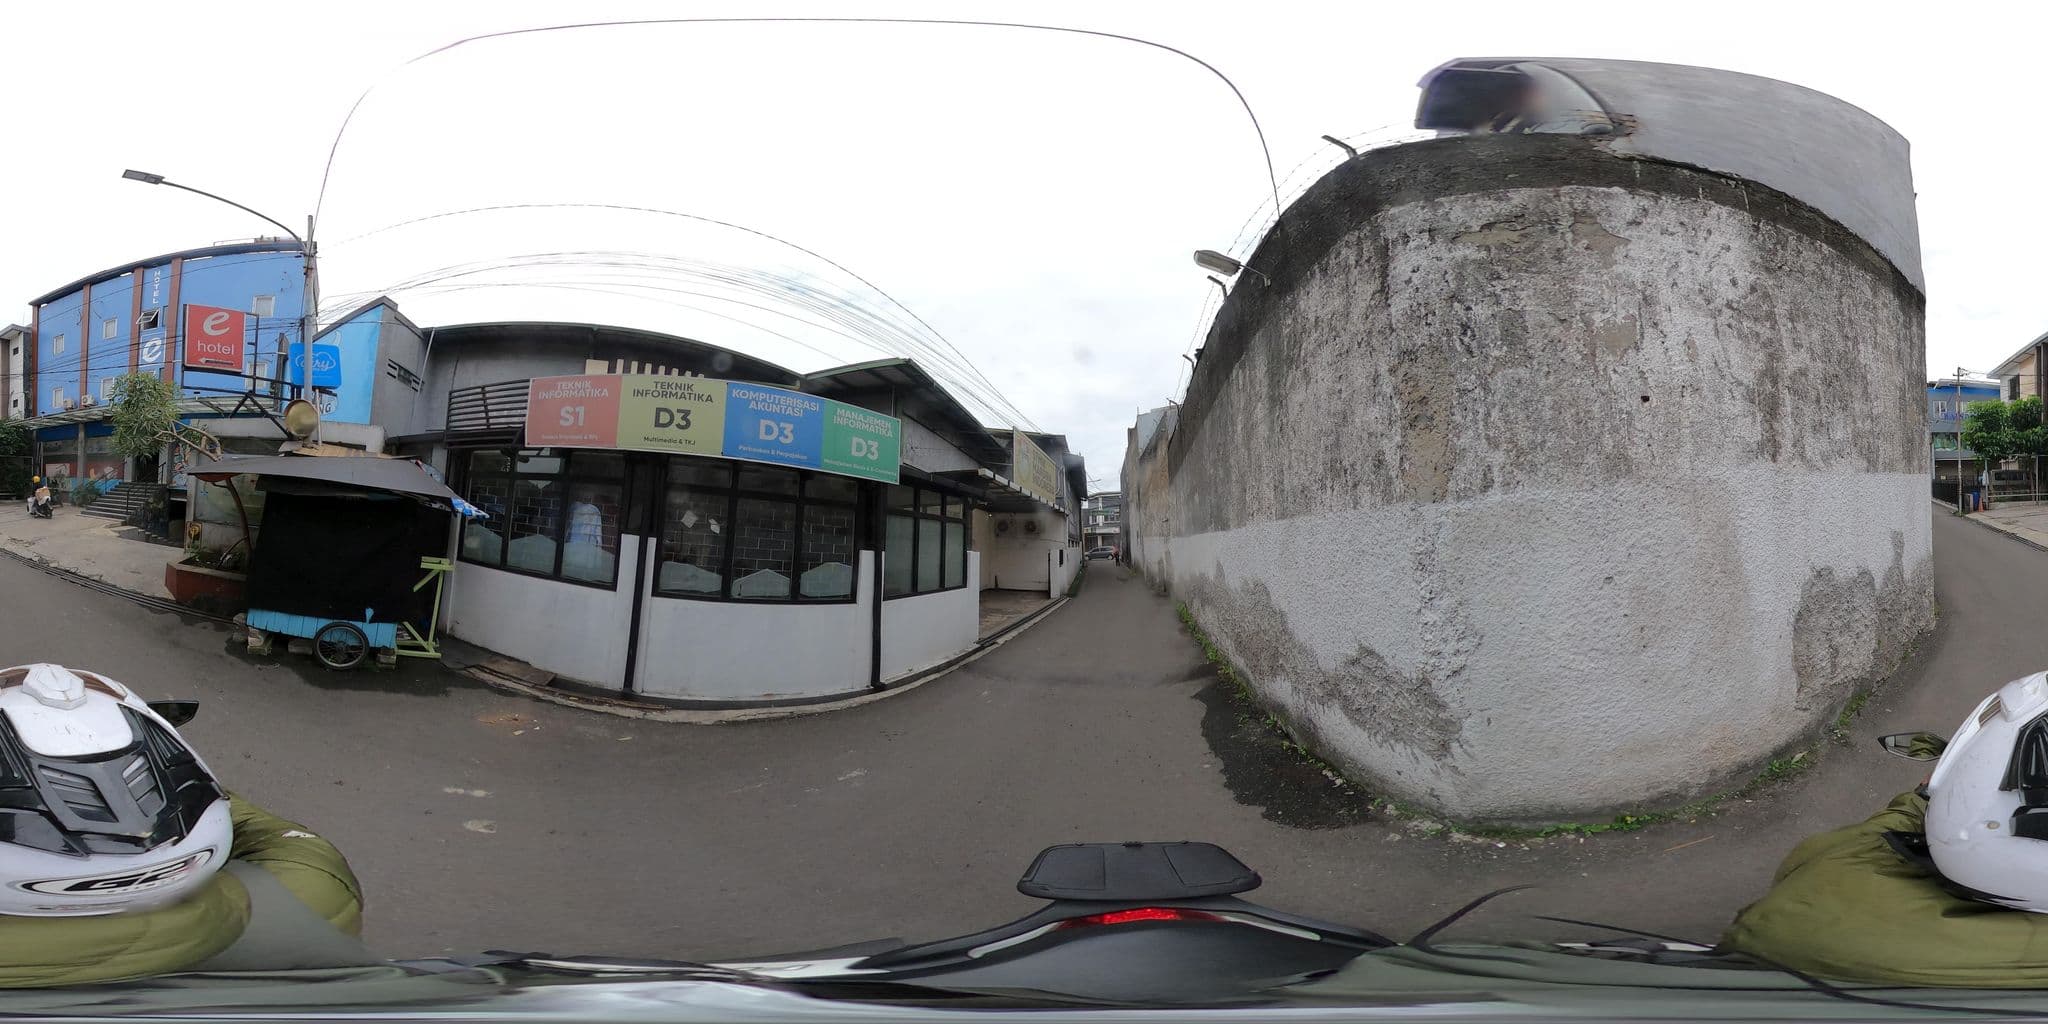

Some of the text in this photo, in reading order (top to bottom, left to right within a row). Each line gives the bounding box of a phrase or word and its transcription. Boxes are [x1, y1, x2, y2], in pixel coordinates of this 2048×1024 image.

[153, 271, 161, 304] HOTEL
[203, 311, 230, 336] e
[197, 340, 235, 355] hotel
[538, 388, 609, 400] INFORMATIKA
[557, 380, 592, 391] TEKNIK
[632, 388, 714, 403] INFORMATIKA
[653, 381, 694, 392] TEKNIK
[732, 388, 819, 412] KOMPUTERISASI
[748, 401, 804, 417] AKUNTASI
[559, 405, 585, 427] S1
[654, 407, 692, 430] D3
[833, 415, 893, 438] INFORMATIKA
[836, 408, 892, 430] MANAJEMEN
[759, 419, 794, 444] D3
[851, 436, 879, 461] D3
